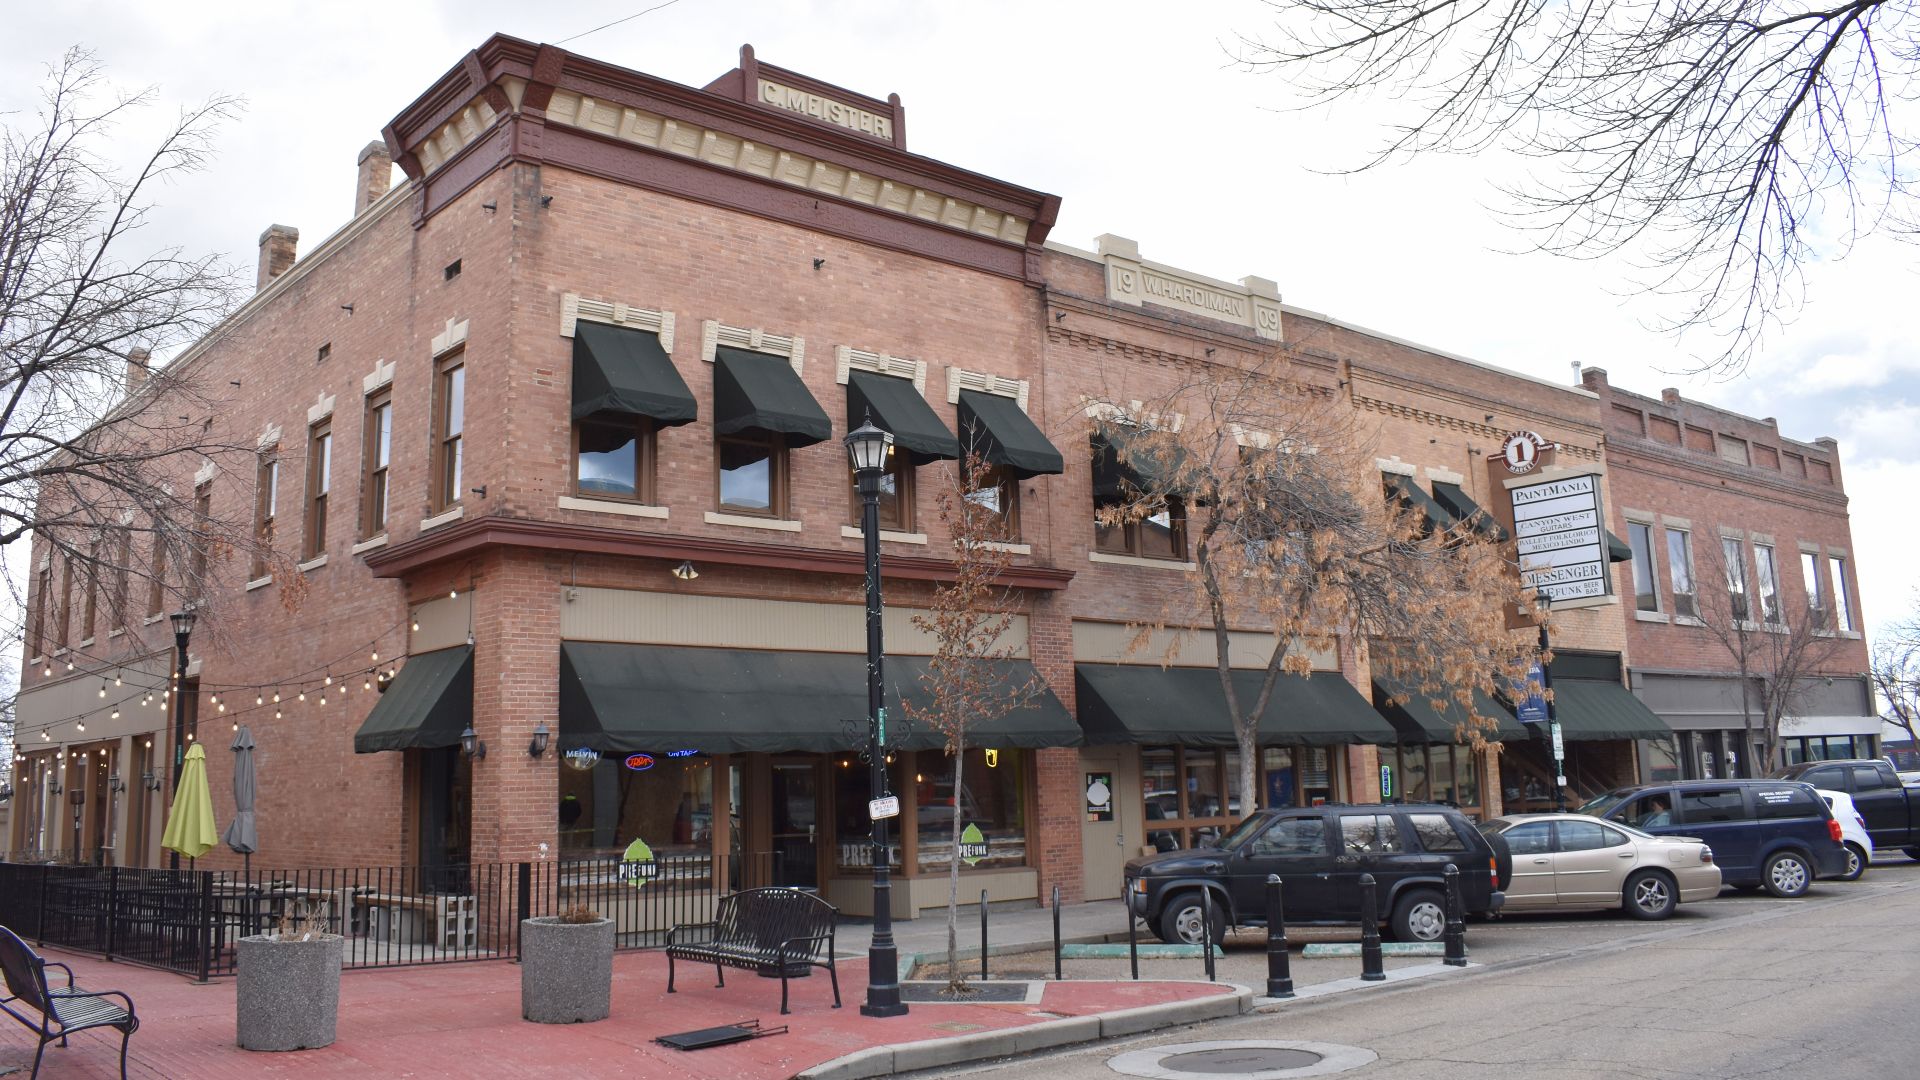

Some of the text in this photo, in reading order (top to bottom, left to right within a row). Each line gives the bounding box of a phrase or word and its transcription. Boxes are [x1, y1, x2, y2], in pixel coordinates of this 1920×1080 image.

[1116, 268, 1135, 293] 19
[1258, 307, 1279, 331] 09
[1513, 441, 1531, 463] 1
[1510, 461, 1535, 473] MARKET
[1521, 512, 1592, 530] CANYON WEST
[1540, 523, 1573, 533] GUITARS
[1549, 529, 1597, 542] FOLKLORICO
[1532, 538, 1585, 551] MEXICO LINDO
[1527, 564, 1598, 584] MESSENGER
[1583, 581, 1599, 589] BEER
[566, 750, 598, 760] MELVIN
[842, 844, 895, 866] PREFK
[958, 844, 987, 858] PREFUNK
